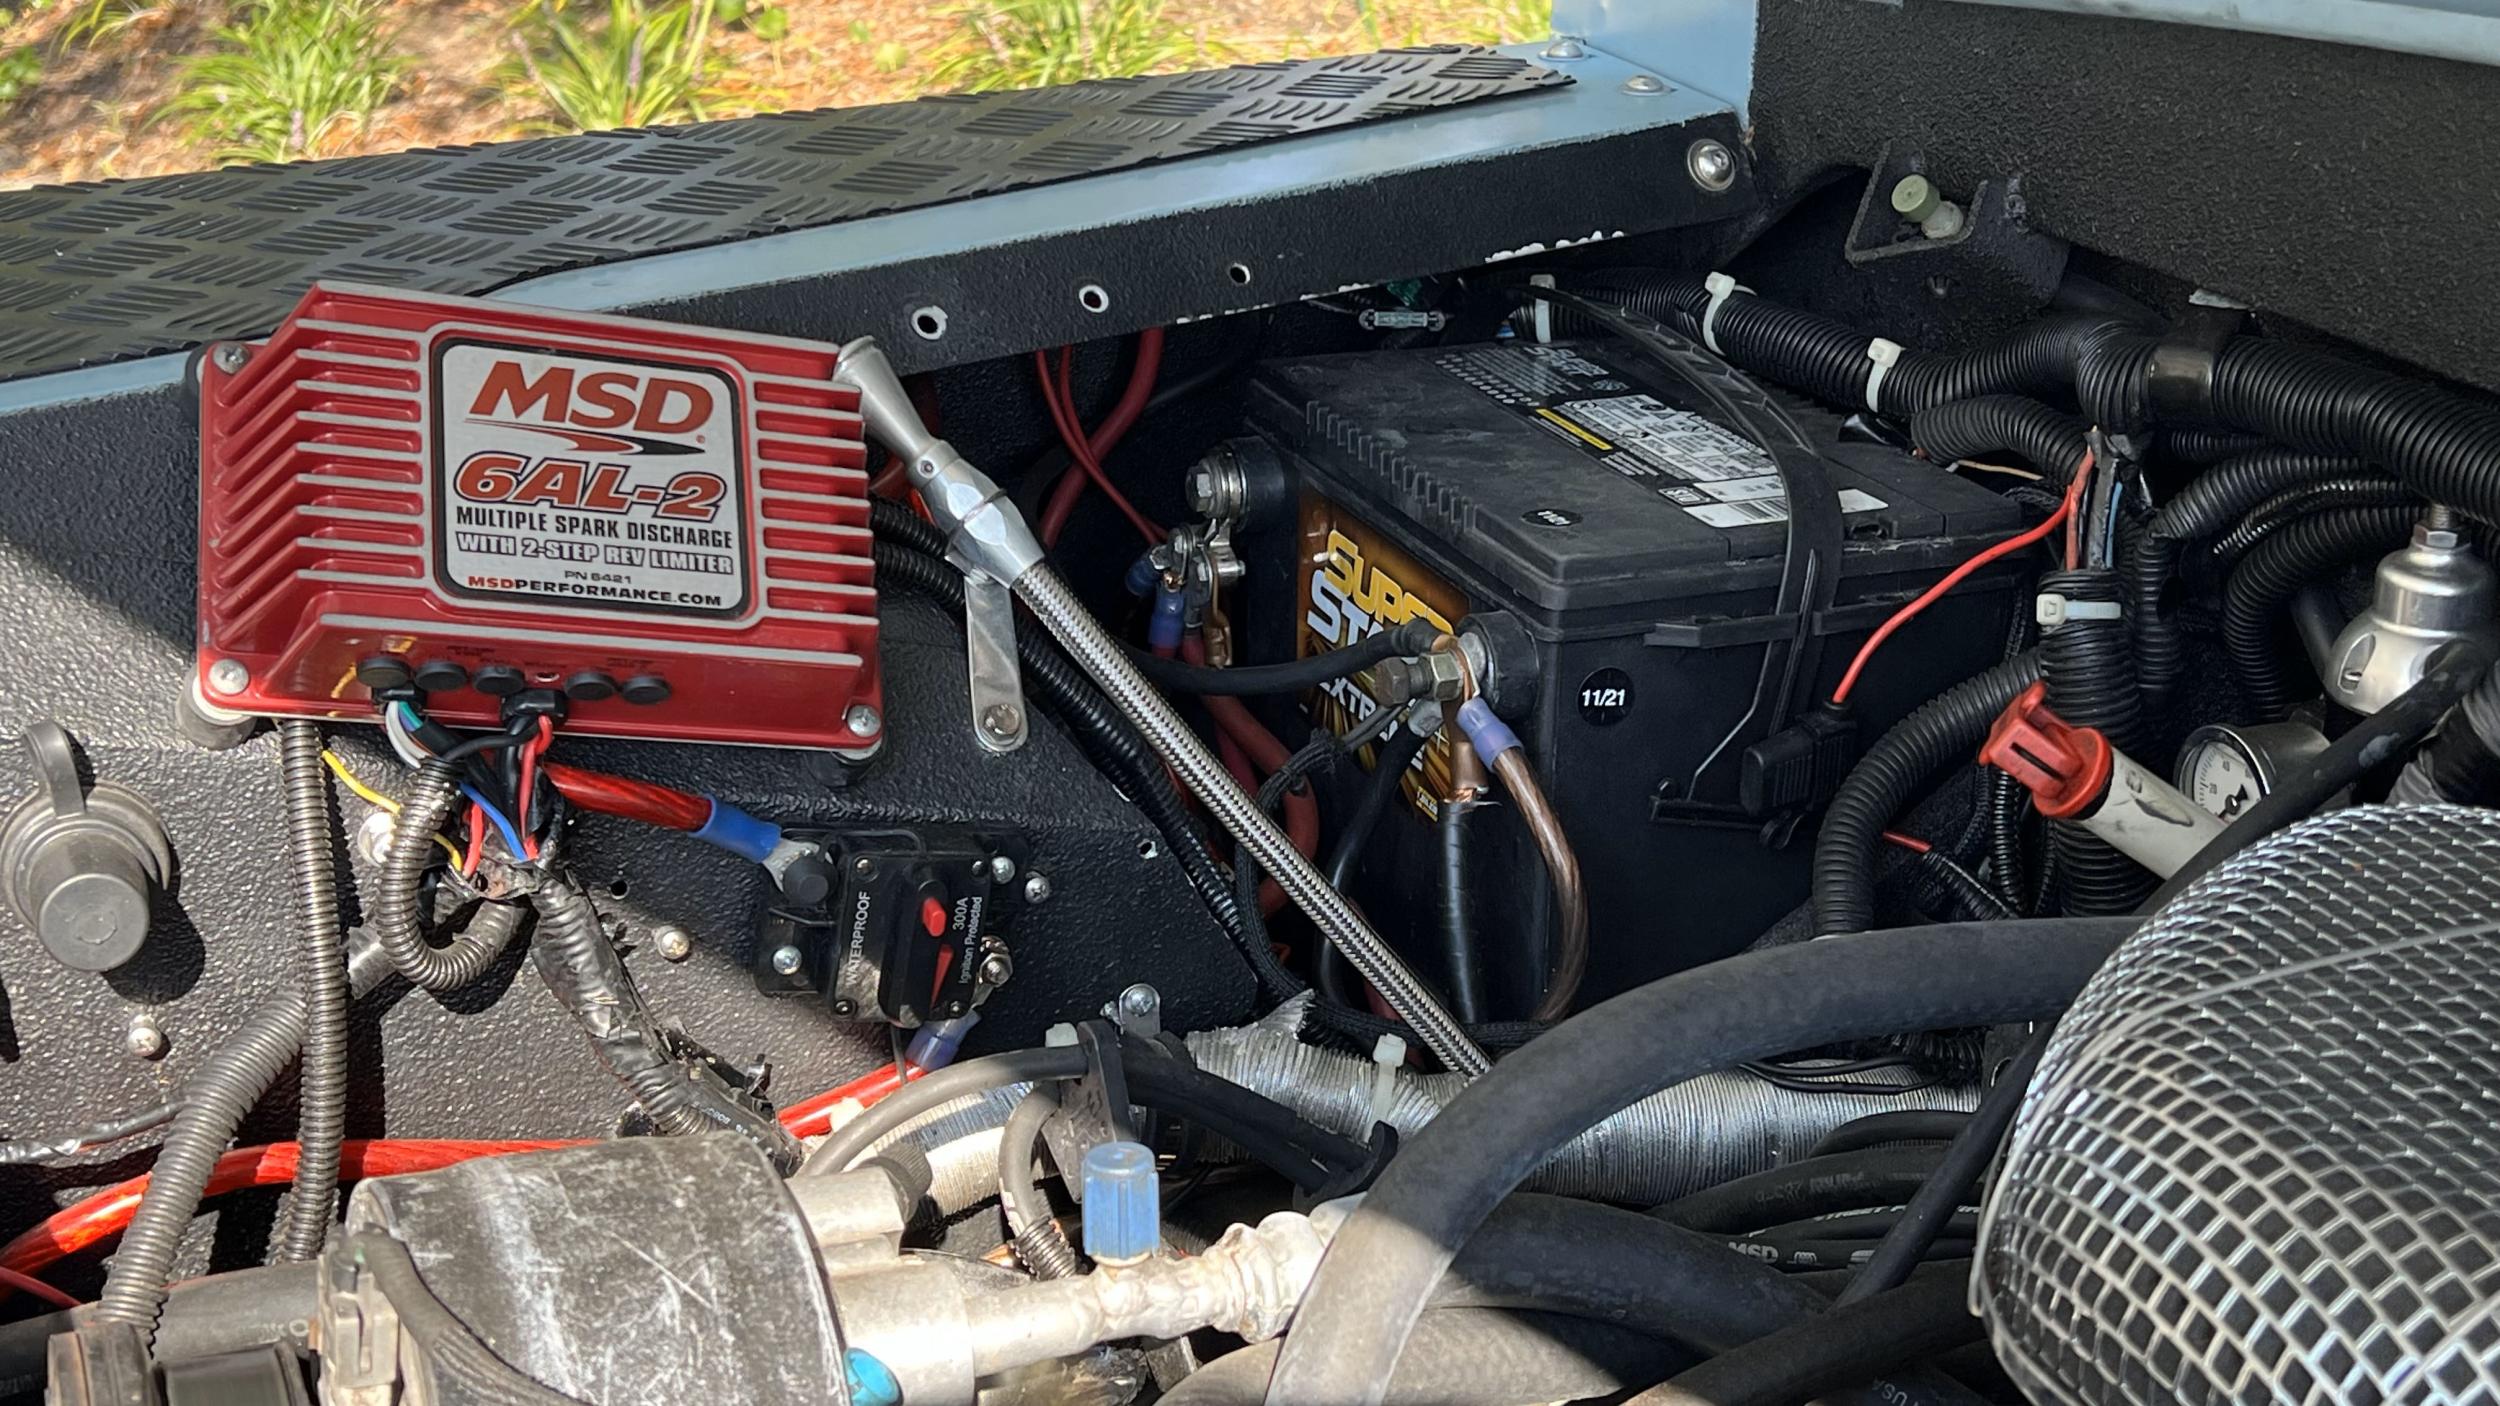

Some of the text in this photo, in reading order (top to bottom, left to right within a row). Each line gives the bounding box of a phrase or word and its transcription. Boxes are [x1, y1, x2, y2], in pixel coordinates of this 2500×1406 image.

[469, 361, 714, 434] MSD
[453, 451, 727, 523] 6AL-2
[456, 506, 732, 549] MULTIPLE SPARK DISCHARGE
[455, 531, 734, 575] WITH 2-STEP REV LIMITER
[468, 575, 721, 606] MSDPERFORMANCE.COM
[564, 570, 588, 580] PN
[1582, 688, 1626, 706] 11/21
[952, 897, 969, 930] 300A
[845, 891, 872, 986] WATERPROOF
[959, 896, 983, 985] Ignition Protected
